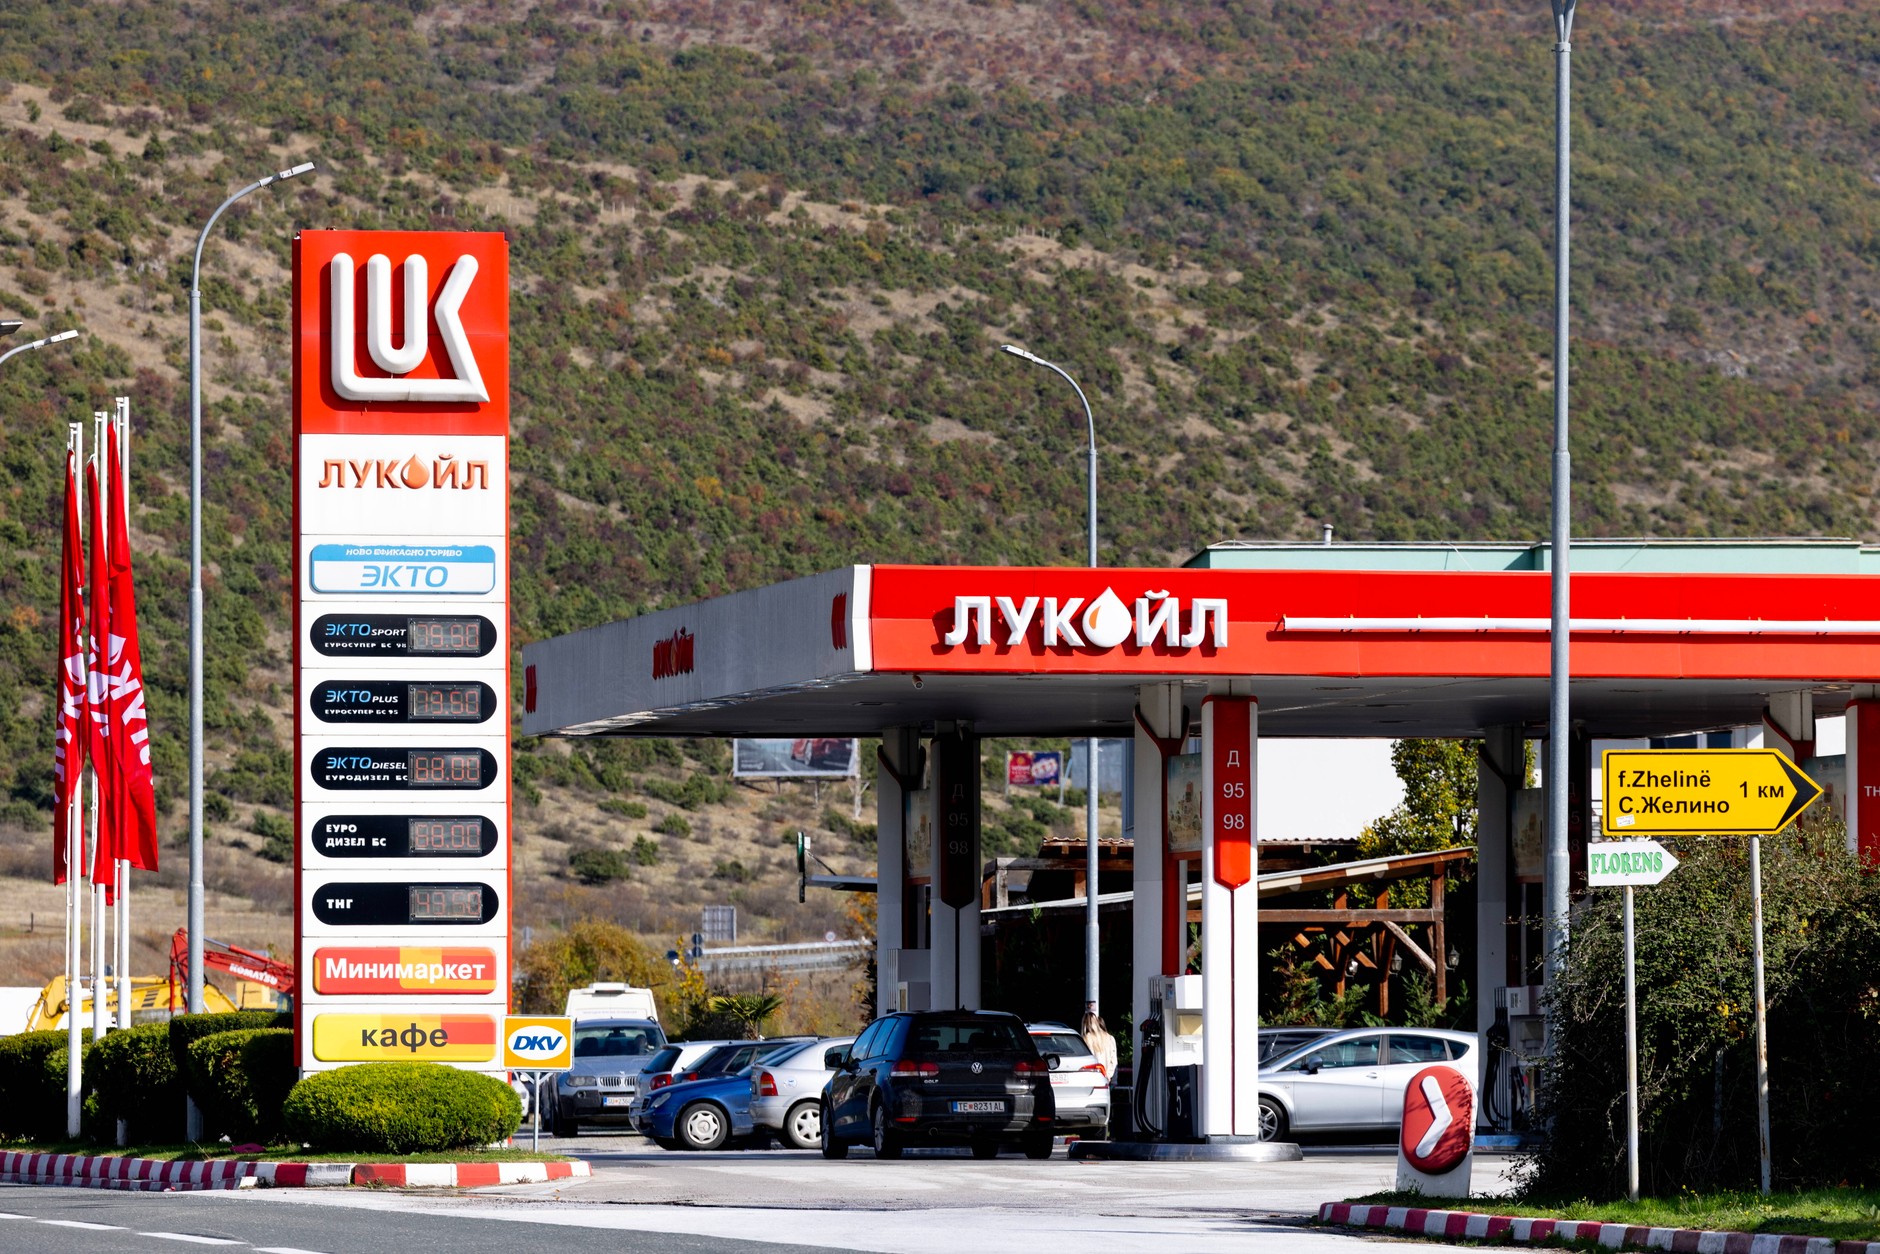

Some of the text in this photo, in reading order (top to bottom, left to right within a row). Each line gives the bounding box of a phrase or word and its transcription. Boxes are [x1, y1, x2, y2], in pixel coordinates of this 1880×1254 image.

[318, 453, 489, 490] ЛУКОЙЛ
[346, 548, 372, 556] НОВО
[425, 549, 463, 557] ГОРИВО
[360, 565, 449, 588] ЭКТО
[944, 586, 1229, 648] ЛУКОЙЛ
[1226, 750, 1240, 767] Д
[1618, 770, 1712, 788] f.Zhelinë
[1223, 783, 1245, 799] 95
[1739, 781, 1748, 798] 1
[1618, 796, 1730, 814] С.Желино
[949, 812, 969, 827] 95
[1223, 814, 1245, 830] 98
[326, 824, 358, 833] ЕУРО
[325, 838, 387, 848] ДИЗЕЛ БС
[949, 840, 969, 855] 98
[1590, 851, 1664, 876] FLORENS
[326, 898, 354, 909] ТНГ
[228, 962, 279, 986] KOMATSU
[326, 957, 486, 984] Минимаркет
[361, 1022, 449, 1053] кафе
[512, 1035, 563, 1051] DKV
[958, 1102, 969, 1111] TE
